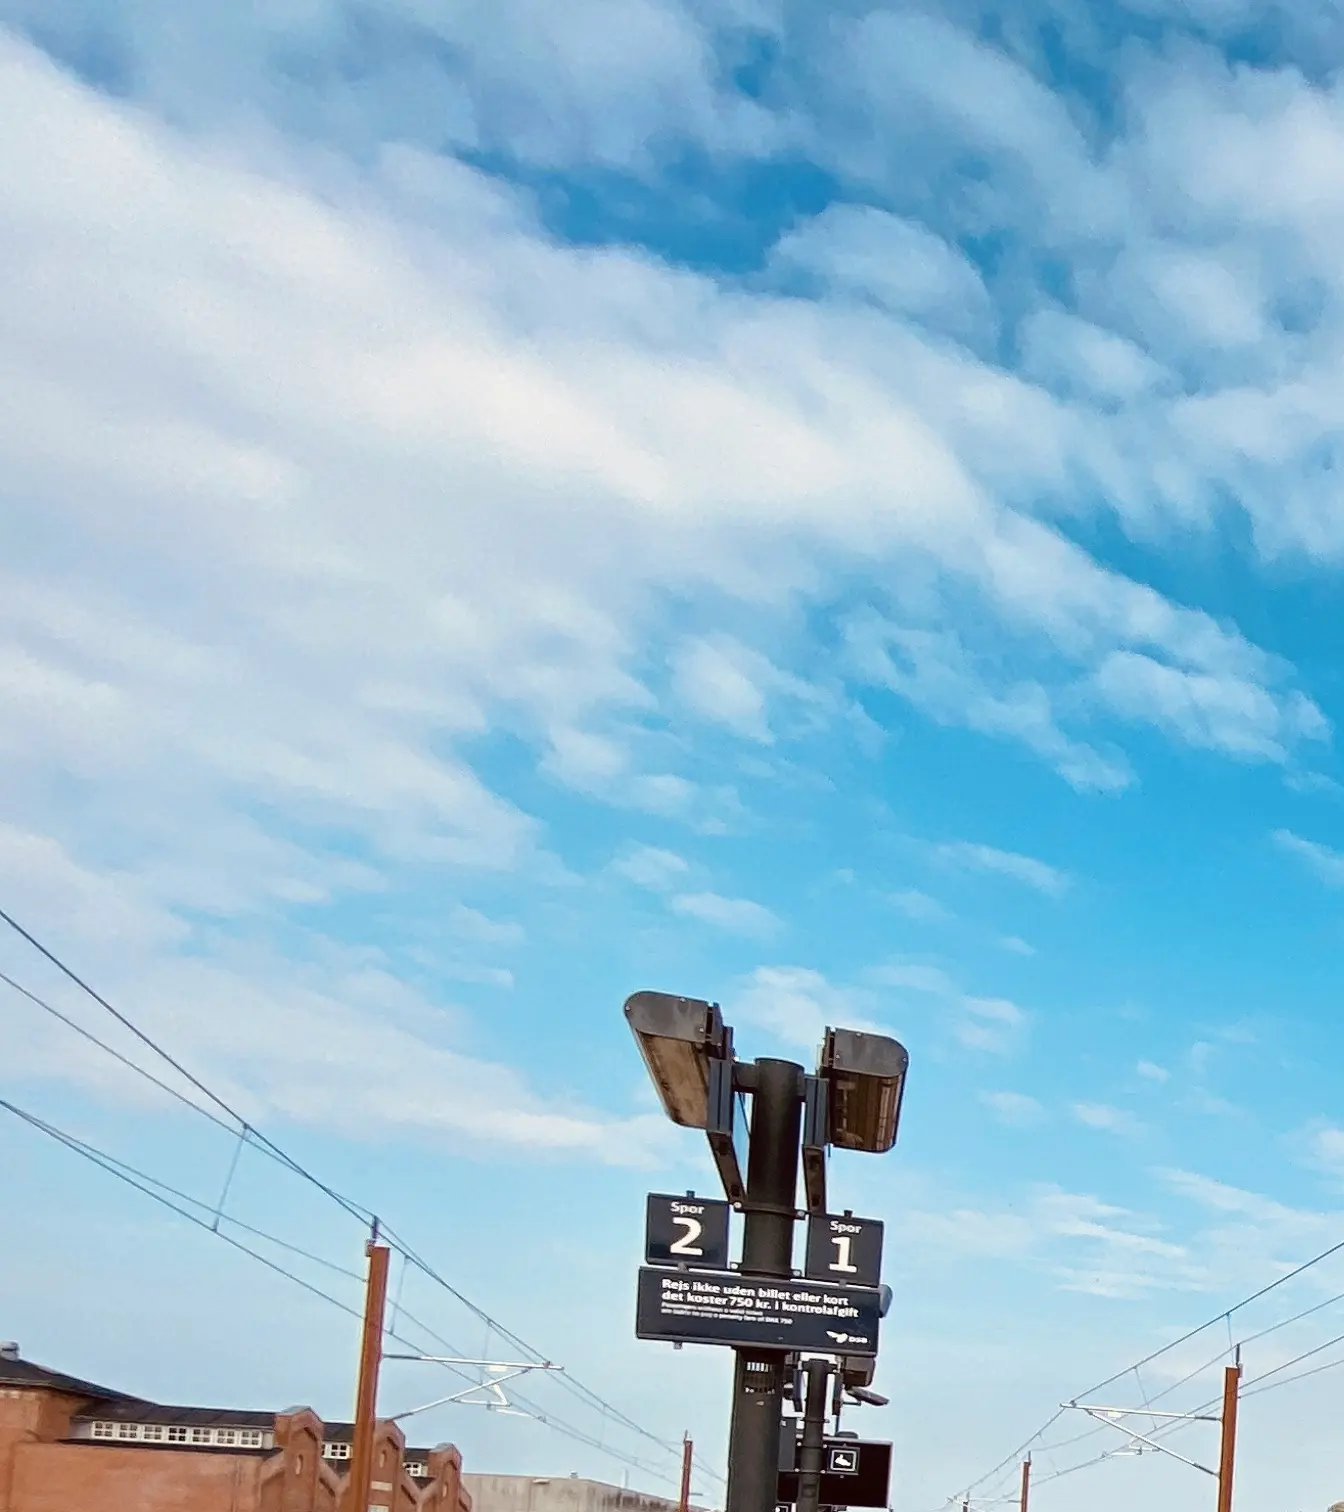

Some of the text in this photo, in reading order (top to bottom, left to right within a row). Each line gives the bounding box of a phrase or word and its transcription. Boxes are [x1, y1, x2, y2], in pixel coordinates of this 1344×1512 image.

[670, 1201, 705, 1215] Spor
[669, 1216, 703, 1256] 2
[829, 1219, 862, 1234] Spor
[828, 1236, 857, 1273] 1
[661, 1278, 849, 1306] Rejs ikke uden billet eller kort
[661, 1290, 684, 1302] det
[686, 1291, 728, 1305] koster
[729, 1296, 754, 1308] 750
[755, 1298, 772, 1310] kr.
[781, 1301, 859, 1318] kontrolafgift
